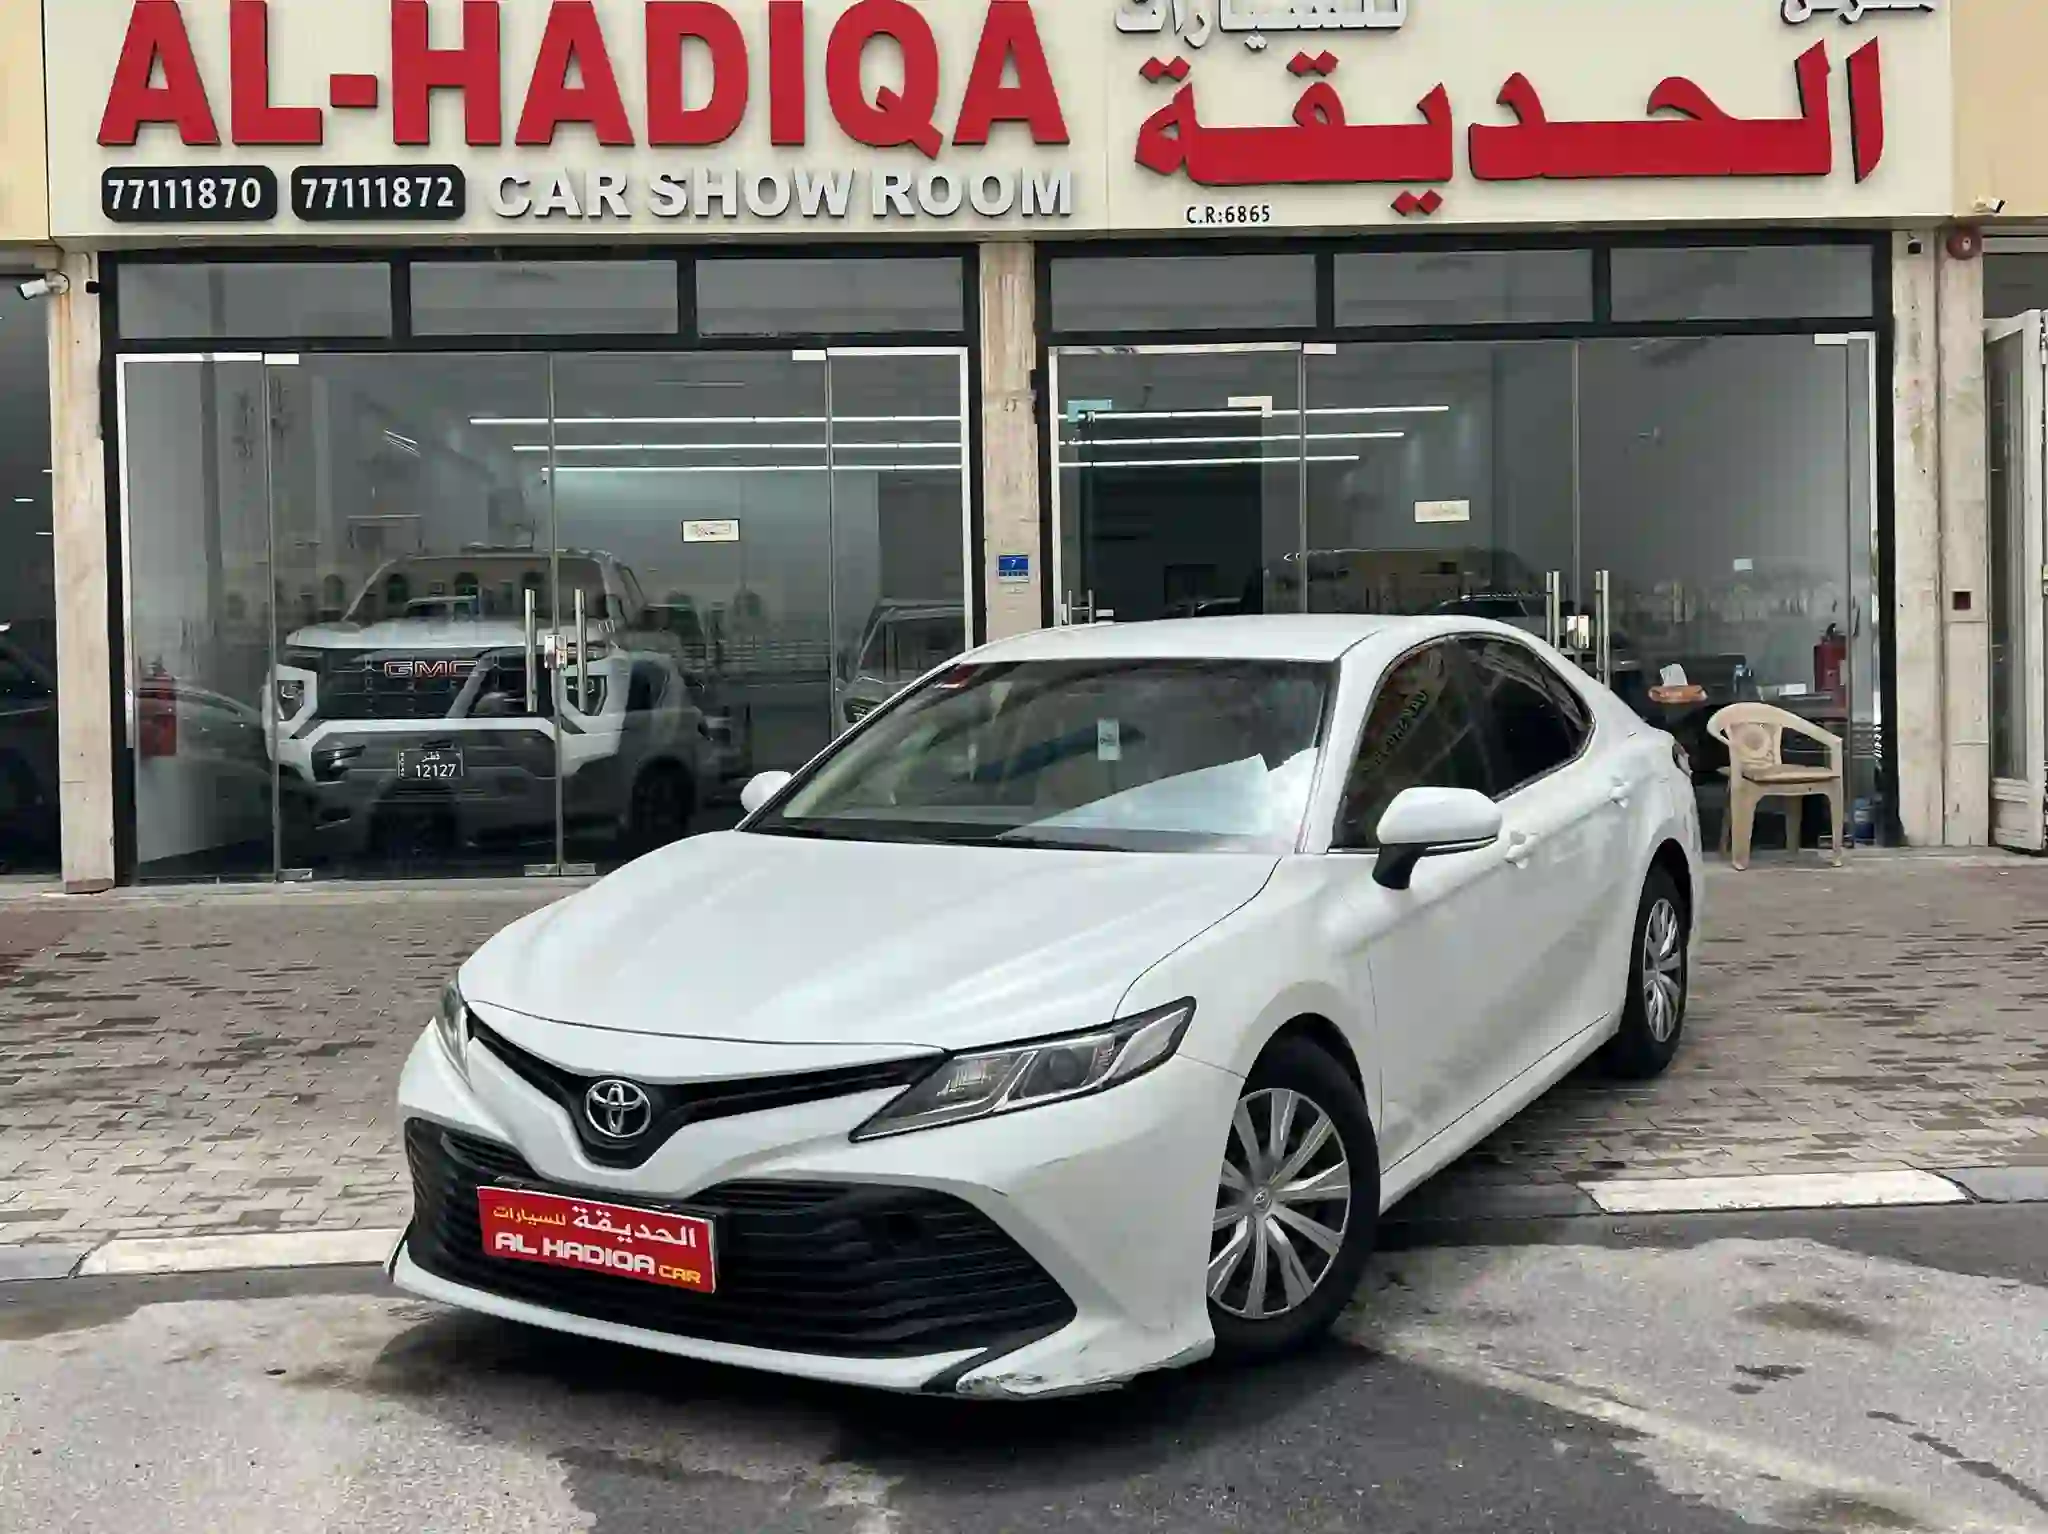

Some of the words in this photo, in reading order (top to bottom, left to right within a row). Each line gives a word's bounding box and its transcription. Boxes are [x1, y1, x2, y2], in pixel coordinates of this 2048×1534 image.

[97, 0, 1070, 160] AL-HADIQA
[1135, 37, 1885, 214] الحديقة
[107, 177, 262, 211] 77111870
[301, 176, 455, 210] 77111872
[492, 167, 632, 218] CAR
[649, 167, 855, 218] SHOW
[872, 167, 1073, 217] ROOM
[1186, 204, 1271, 224] C.R:6865
[384, 660, 478, 678] GMC
[415, 763, 457, 778] 12127
[492, 1206, 567, 1226] للسيارات
[571, 1205, 697, 1248] الحديقة
[495, 1231, 538, 1255] AL
[542, 1236, 656, 1276] HADIQA
[658, 1264, 701, 1284] CAR
